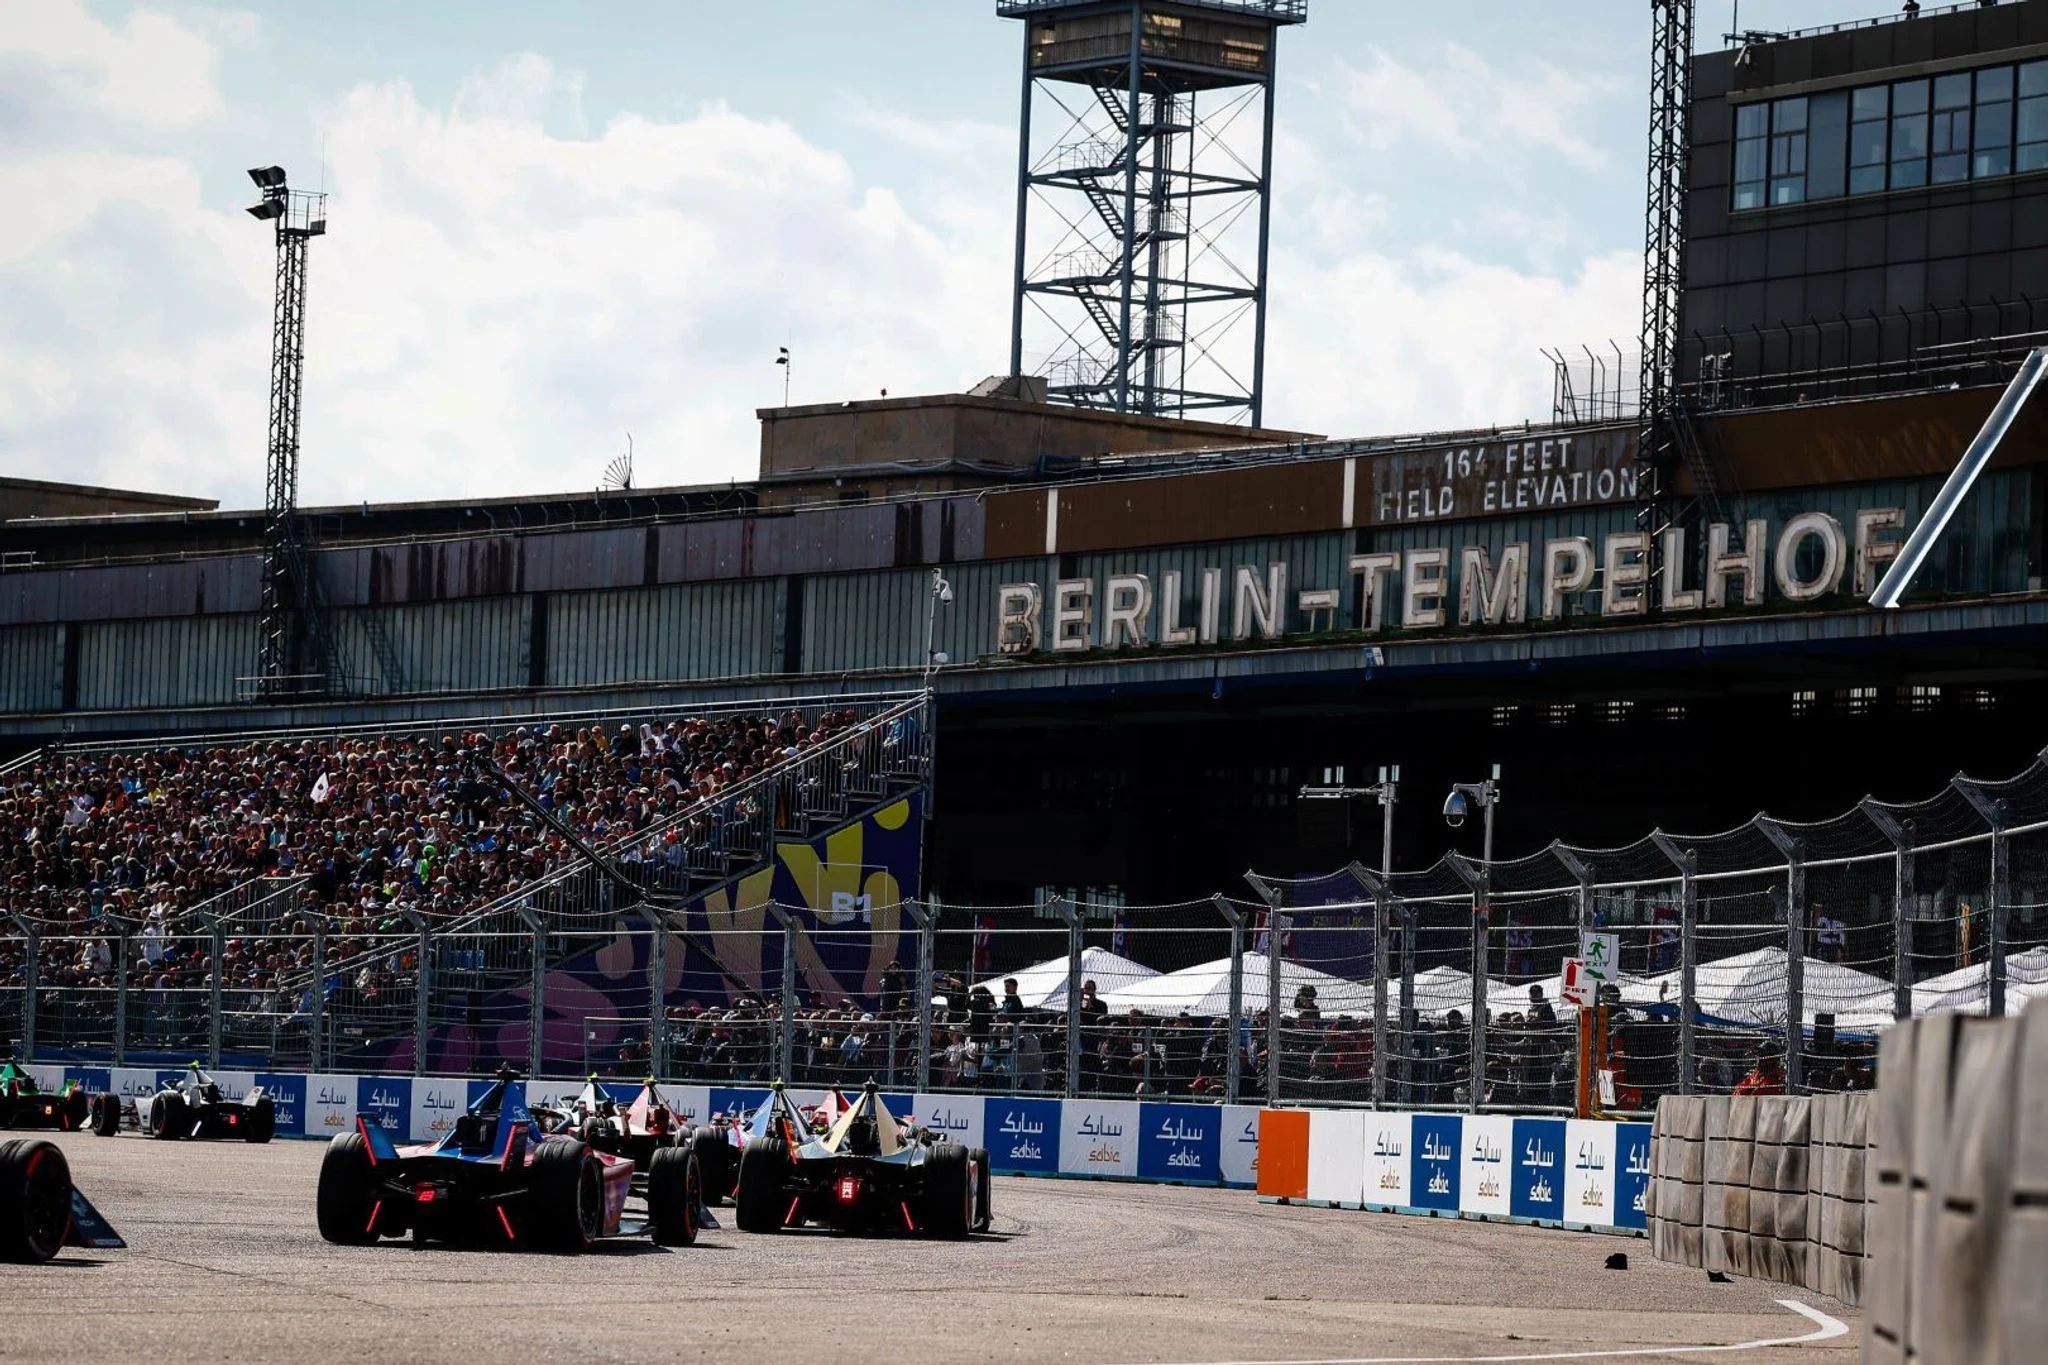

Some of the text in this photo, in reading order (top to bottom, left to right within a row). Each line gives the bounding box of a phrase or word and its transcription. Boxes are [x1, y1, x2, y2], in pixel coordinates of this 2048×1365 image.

[1444, 438, 1572, 479] 164 FEET
[1380, 467, 1638, 521] FIELD ELEVATION
[831, 892, 872, 923] B1
[1565, 986, 1588, 994] FIRE
[380, 1112, 399, 1129] abic
[1010, 1138, 1042, 1159] sabic
[1088, 1142, 1121, 1163] sabic
[1167, 1146, 1201, 1167] sabic
[1380, 1165, 1400, 1189] sabic
[1428, 1167, 1450, 1194] sabic
[1478, 1171, 1500, 1197] sabic
[1529, 1174, 1552, 1202] sabic
[1582, 1178, 1603, 1207] sabic
